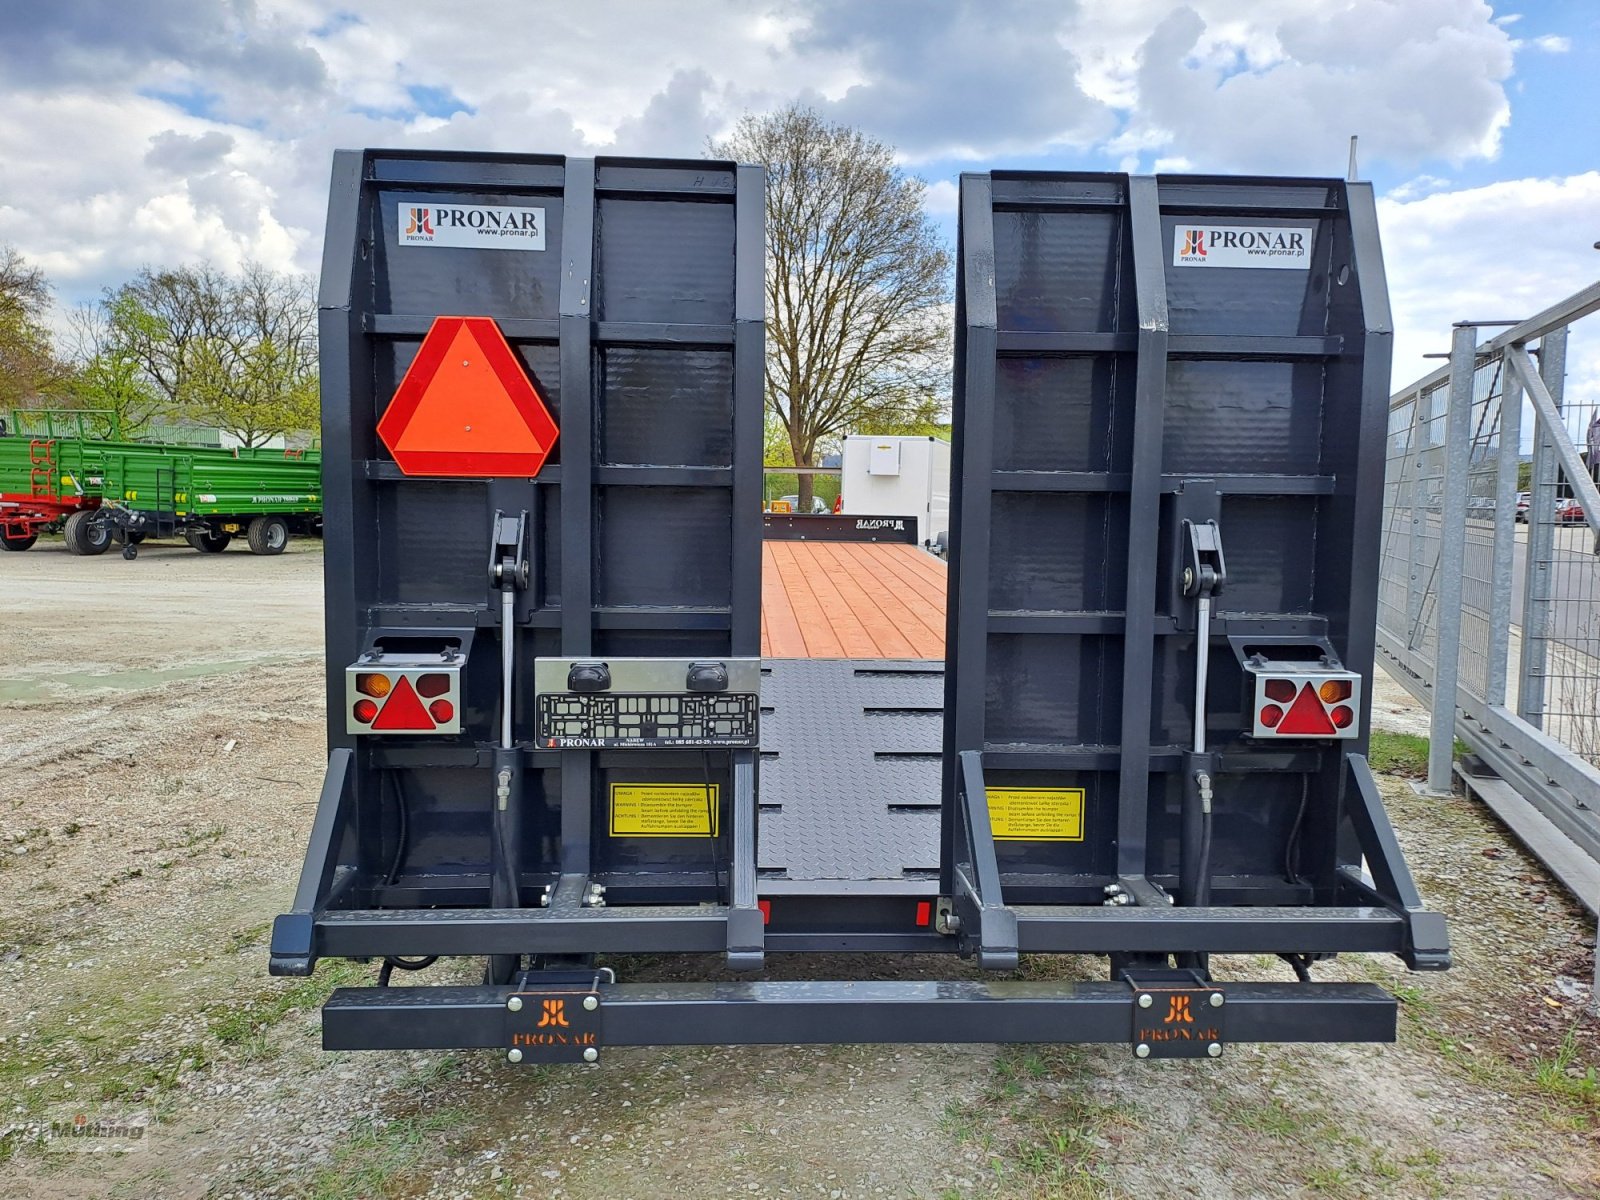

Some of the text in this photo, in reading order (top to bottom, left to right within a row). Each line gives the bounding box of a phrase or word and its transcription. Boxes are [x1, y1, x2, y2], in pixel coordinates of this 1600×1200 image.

[436, 208, 537, 230] PRONAR
[477, 228, 538, 237] www.pronar.pl
[1209, 230, 1304, 249] PRONAR
[1248, 249, 1304, 257] www.pronar.pl
[560, 738, 605, 747] PRONAR
[513, 1031, 596, 1046] PRONAR
[1139, 1028, 1219, 1041] PRONAR
